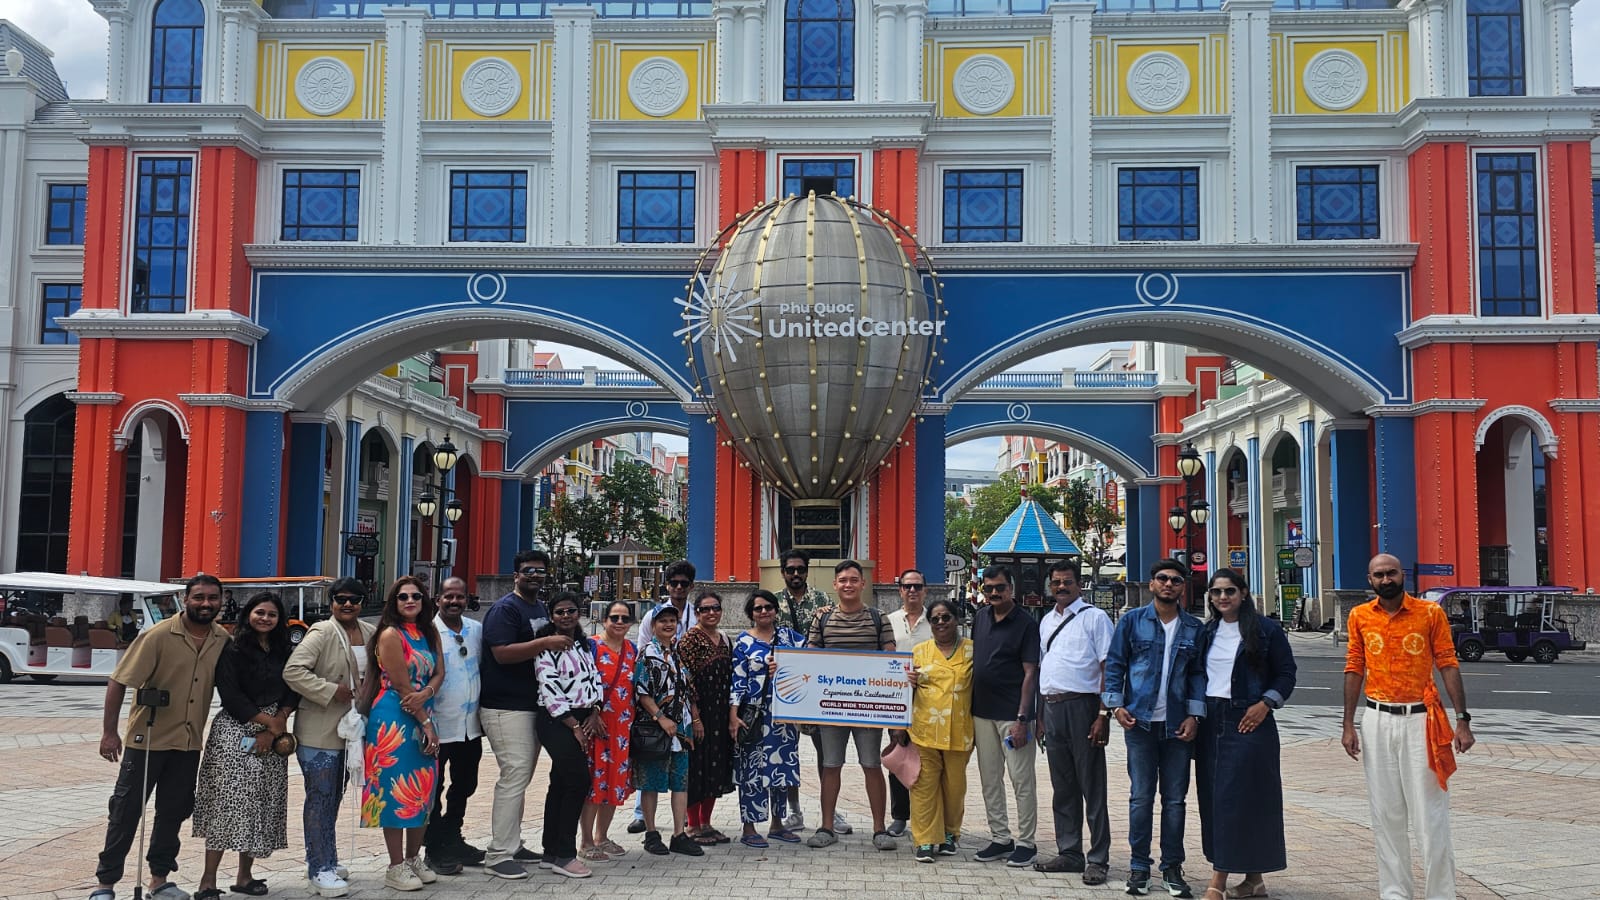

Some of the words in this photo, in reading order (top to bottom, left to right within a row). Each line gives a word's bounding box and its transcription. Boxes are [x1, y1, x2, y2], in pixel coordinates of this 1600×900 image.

[779, 302, 810, 315] Phu
[814, 302, 855, 317] Quoc
[768, 315, 946, 338] UnitedCenter
[817, 674, 834, 686] Sky
[836, 675, 867, 686] Planet
[868, 677, 909, 689] Holidays
[823, 688, 853, 698] Experience
[854, 689, 863, 697] the
